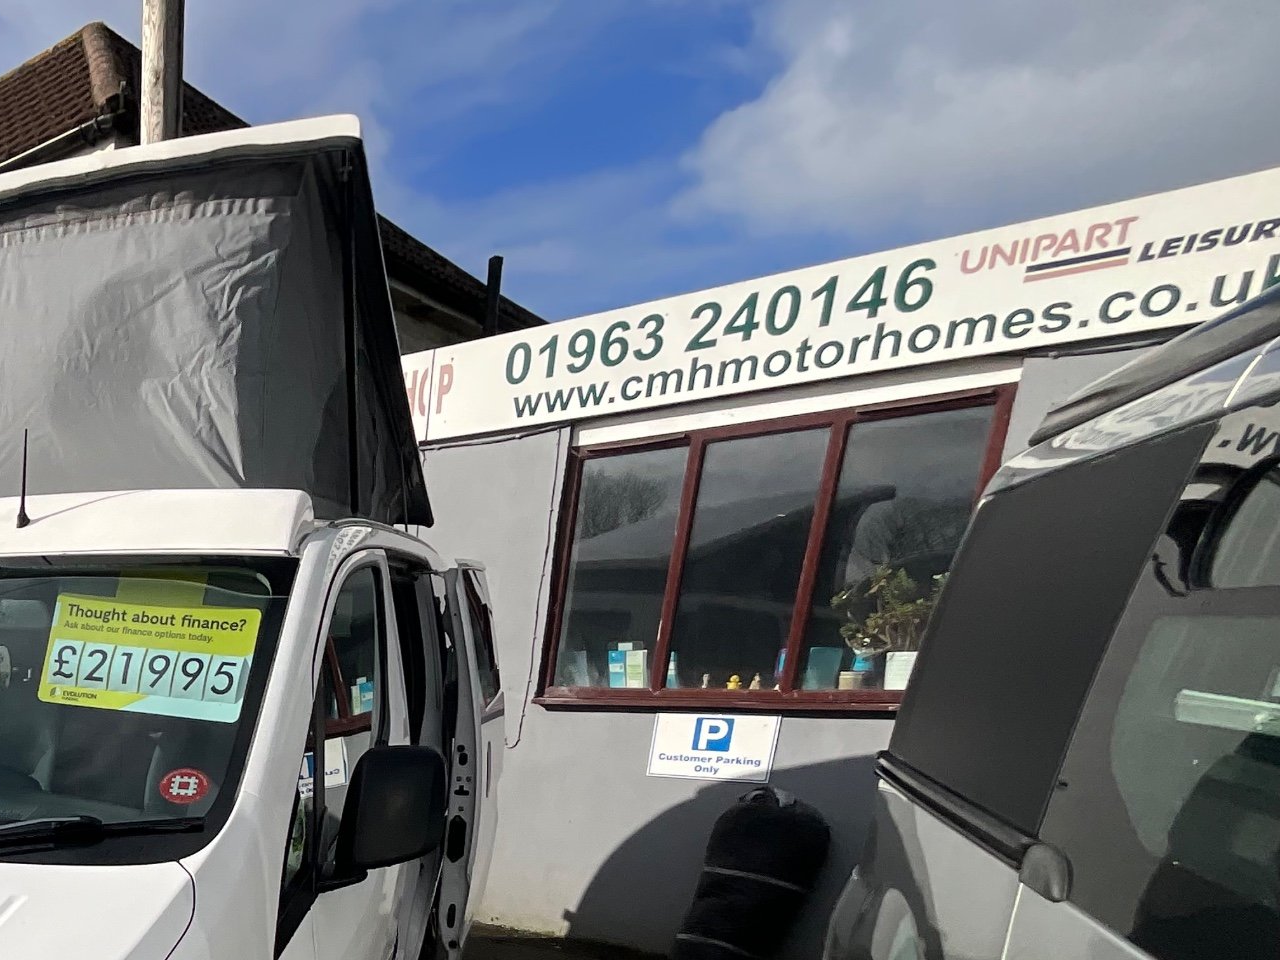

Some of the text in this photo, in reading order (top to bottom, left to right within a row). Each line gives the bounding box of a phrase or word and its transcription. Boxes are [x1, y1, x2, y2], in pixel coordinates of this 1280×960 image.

[961, 216, 1139, 274] UNIPART
[505, 257, 936, 385] 01963 240146
[64, 620, 214, 643] Ask about our finance options today.
[68, 604, 247, 632] Thought about finance?
[52, 645, 237, 696] £21995
[62, 690, 98, 700] EVOLUTION
[697, 718, 729, 750] P
[658, 752, 761, 767] Customer Parking
[694, 764, 720, 775] Only
